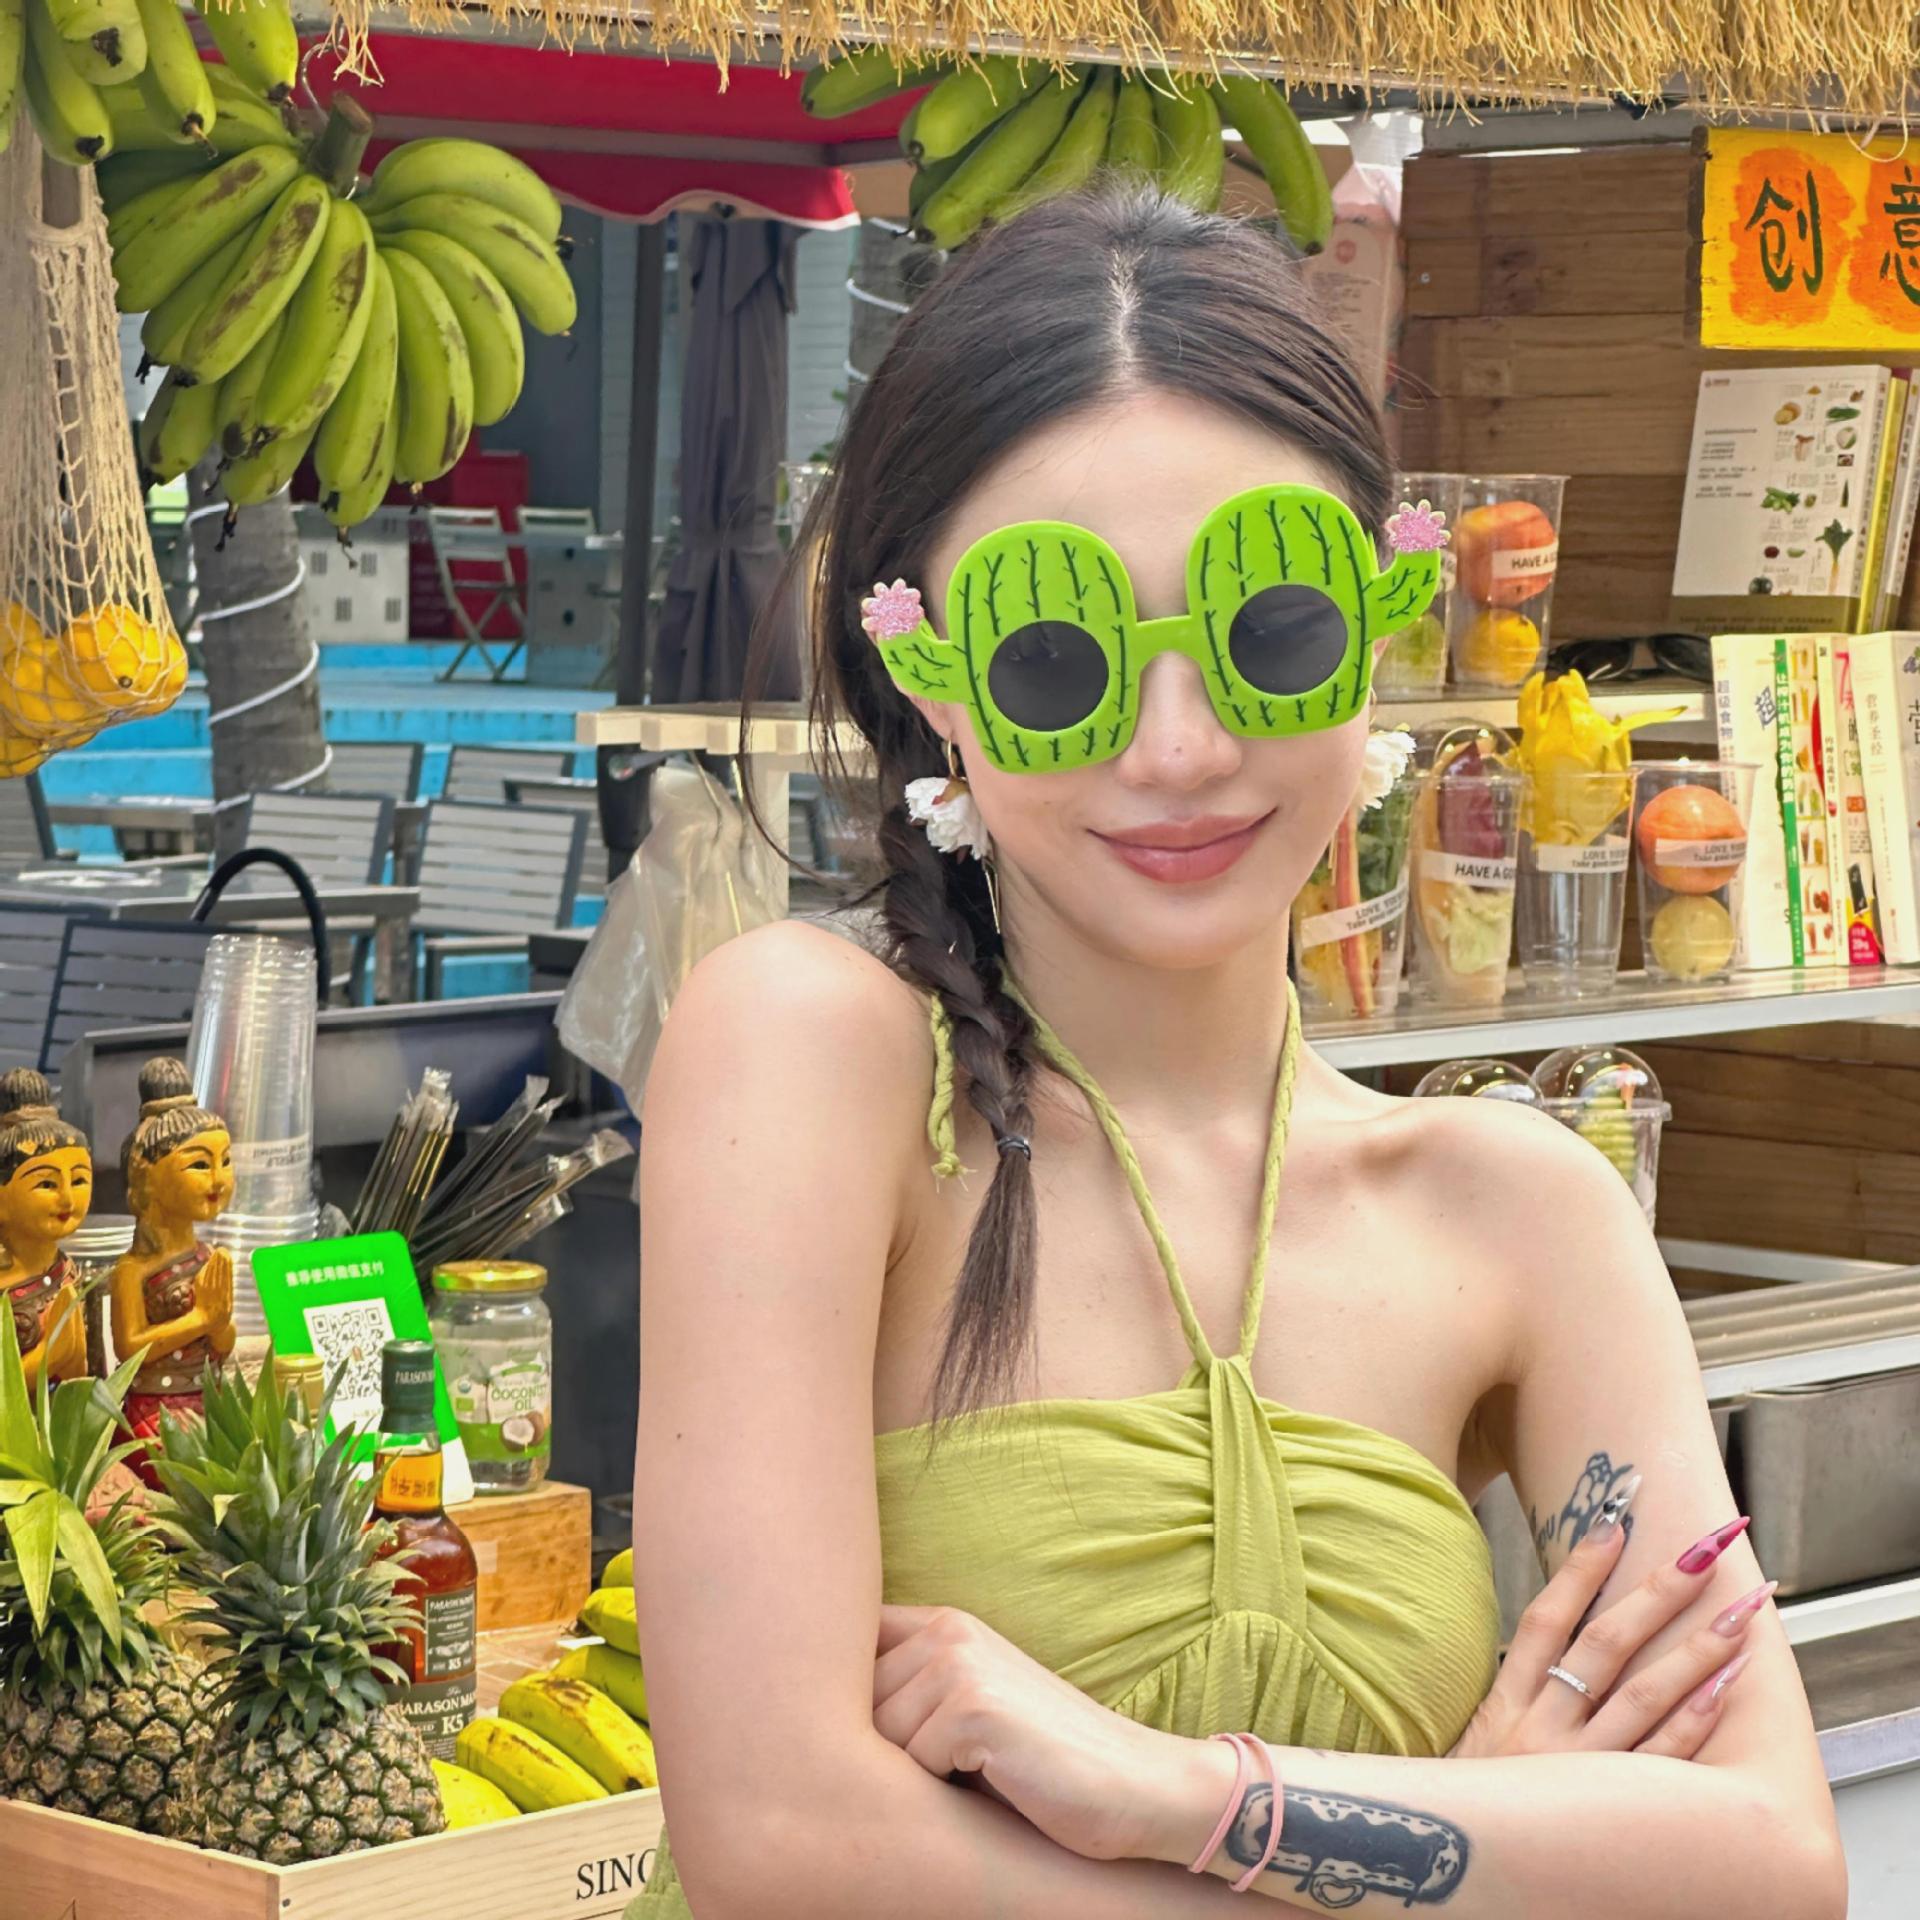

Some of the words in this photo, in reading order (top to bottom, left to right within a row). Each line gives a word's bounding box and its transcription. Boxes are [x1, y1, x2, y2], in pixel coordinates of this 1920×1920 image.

[1511, 555, 1542, 568] HAVE
[1583, 850, 1606, 861] LOVE
[1455, 863, 1490, 879] HAVE
[1492, 867, 1502, 878] A
[491, 1386, 547, 1400] COCONUT
[514, 1399, 534, 1411] OIL
[441, 1713, 464, 1736] K5
